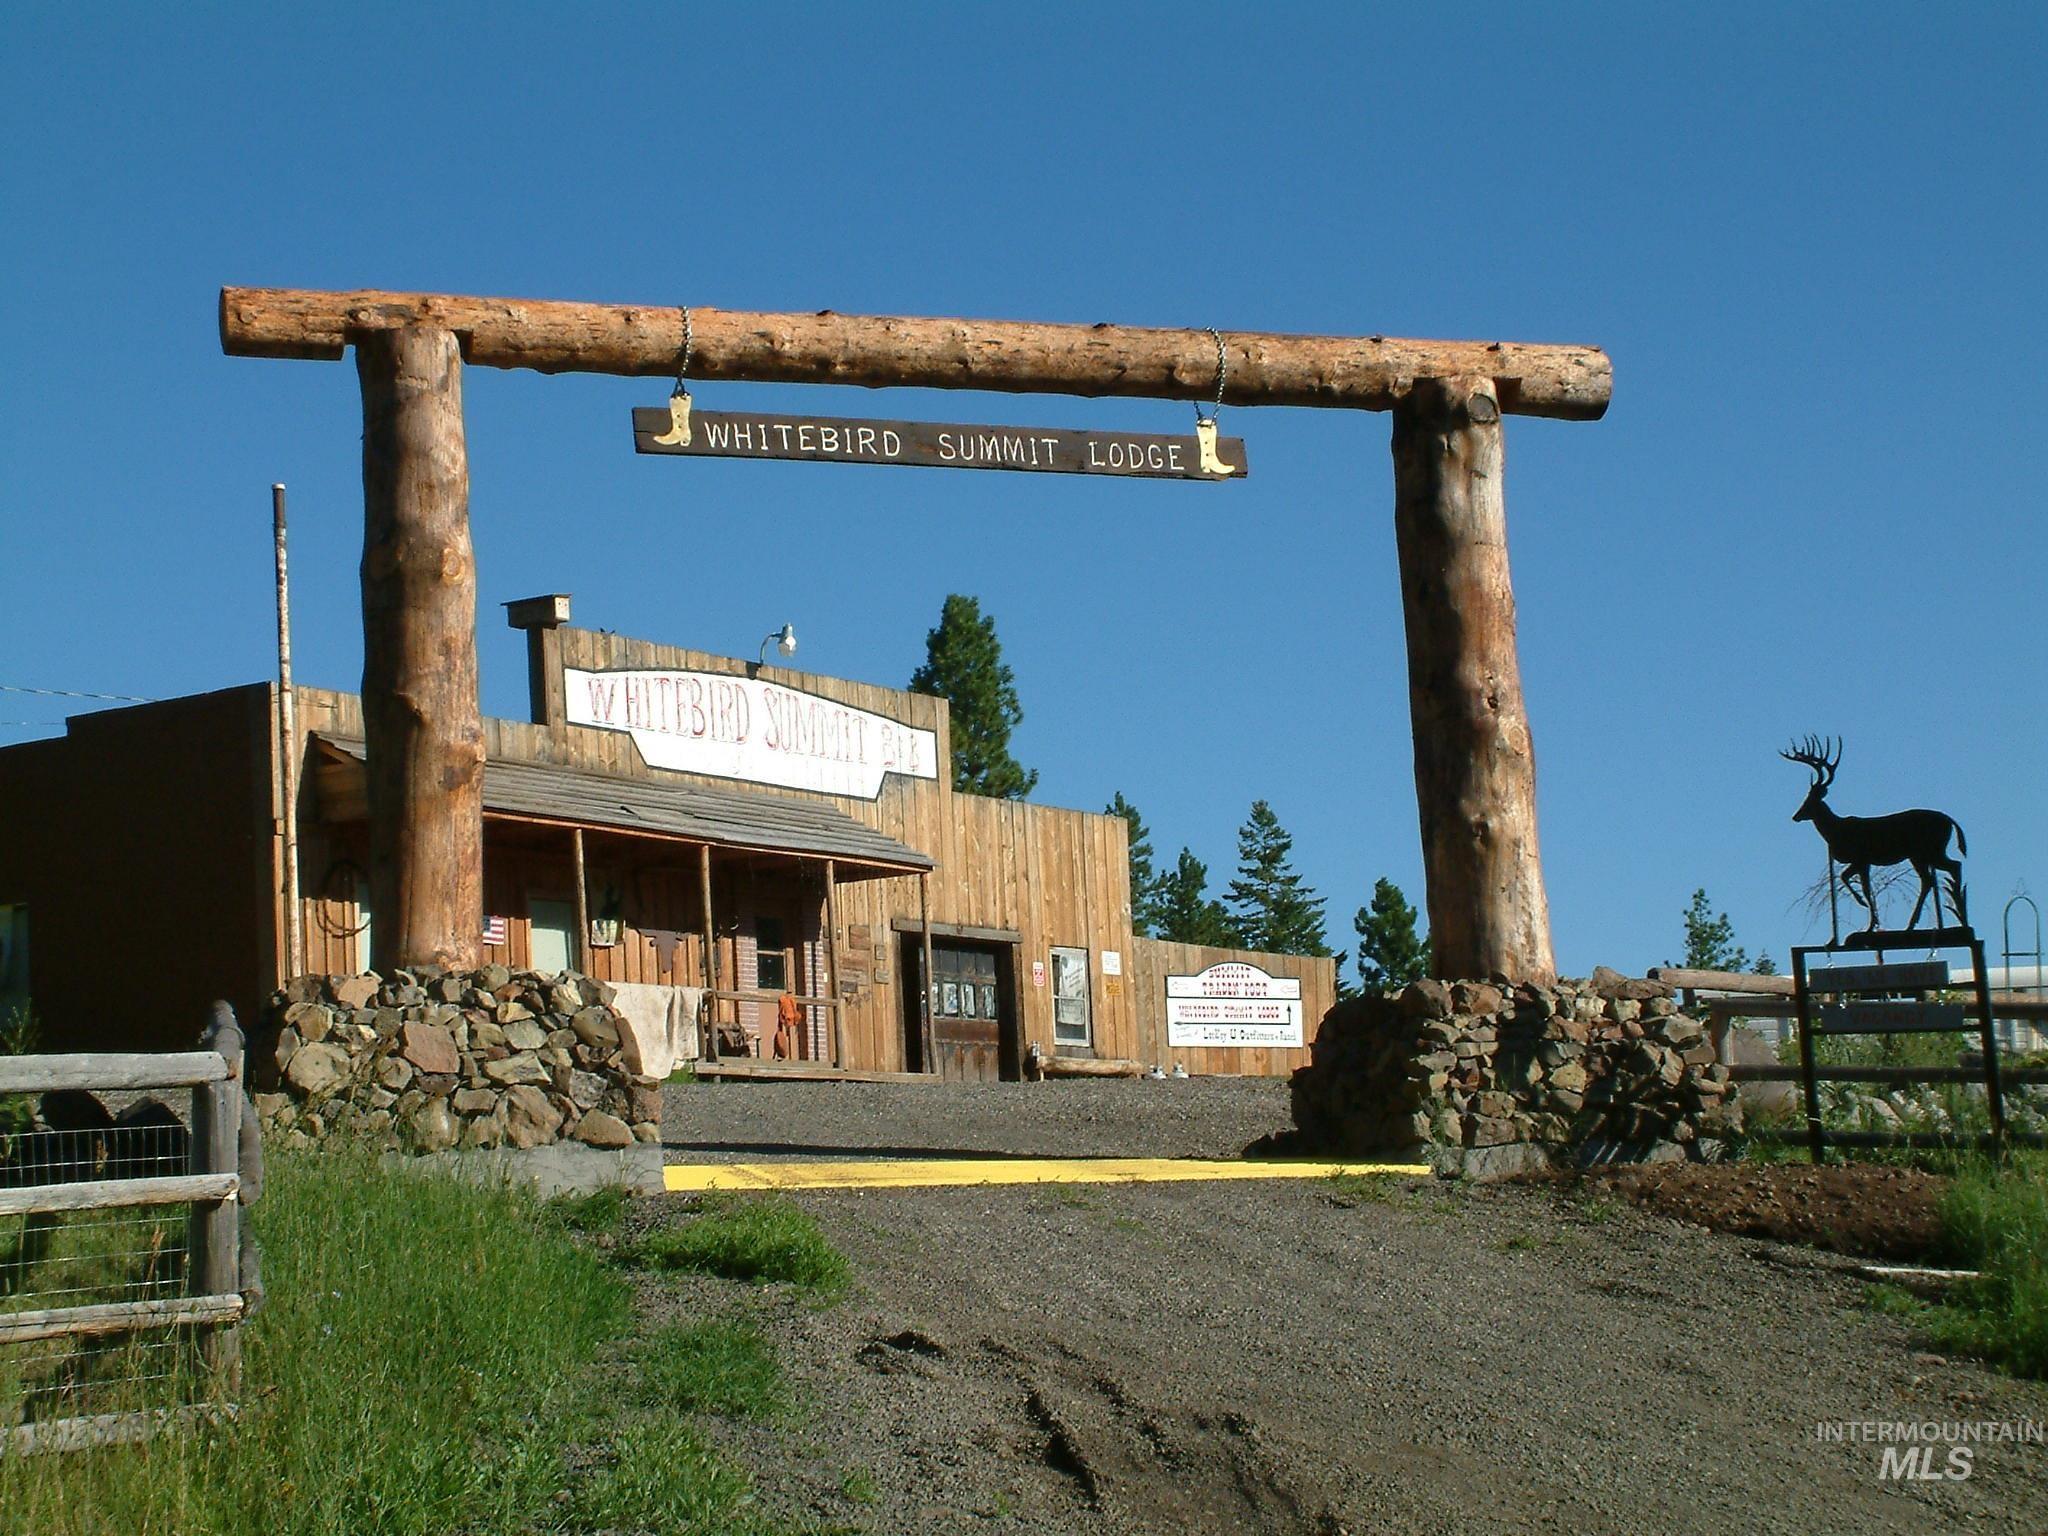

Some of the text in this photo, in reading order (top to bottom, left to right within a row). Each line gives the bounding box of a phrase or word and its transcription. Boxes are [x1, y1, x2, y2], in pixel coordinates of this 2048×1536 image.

[703, 420, 1186, 472] WHITEBIRD SUMMIT LODGE
[586, 676, 751, 745] WHITEBIRD
[763, 687, 868, 764] SUMMIT
